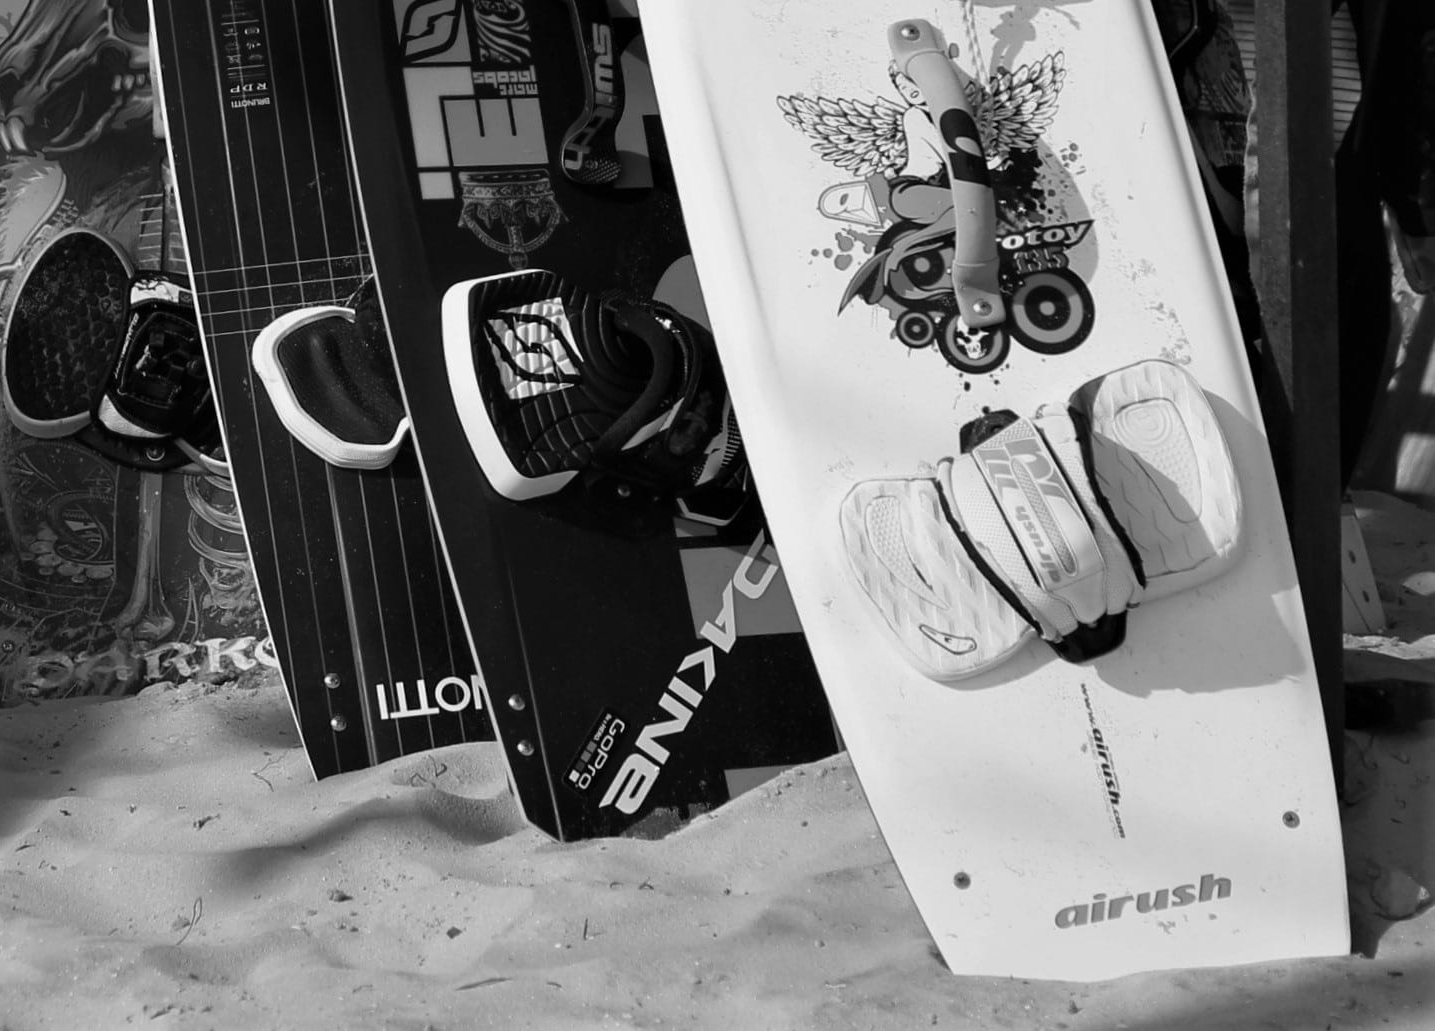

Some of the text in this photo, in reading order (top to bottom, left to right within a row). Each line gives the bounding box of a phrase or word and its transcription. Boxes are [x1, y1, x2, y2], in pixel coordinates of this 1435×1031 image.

[231, 97, 270, 108] BRUNOTTI
[499, 83, 538, 96] marc
[1012, 245, 1069, 274] 135
[1014, 503, 1063, 584] airush
[598, 528, 779, 814] DAKINE
[1080, 682, 1126, 839] www.airush.com
[1054, 873, 1232, 929] airush
